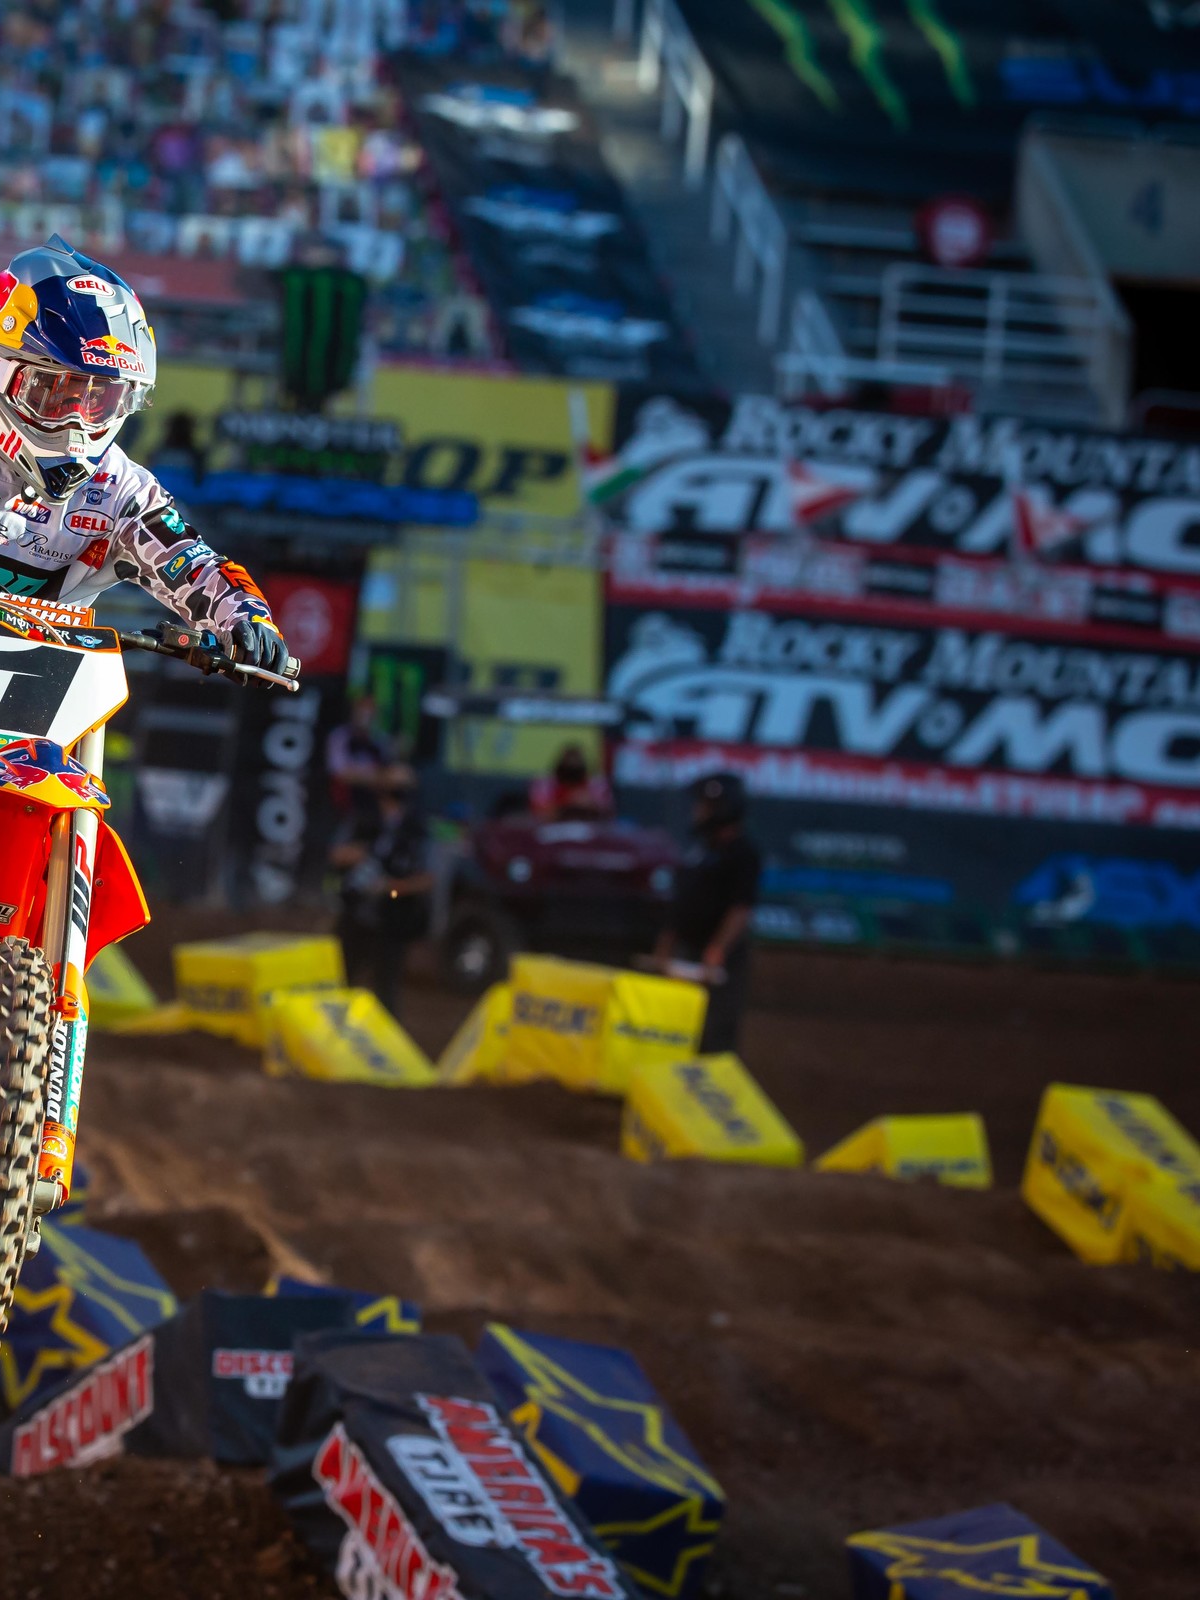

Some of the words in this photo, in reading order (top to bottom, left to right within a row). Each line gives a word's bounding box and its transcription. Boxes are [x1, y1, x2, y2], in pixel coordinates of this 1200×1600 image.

[74, 279, 109, 294] BELL
[82, 351, 117, 369] Red
[118, 354, 147, 376] Bull
[724, 396, 933, 468] ROCKY
[14, 498, 48, 524] 100%
[70, 515, 108, 532] BELL
[718, 605, 912, 679] ROCKY
[386, 1436, 518, 1546] TIRE
[413, 1394, 626, 1598] AMERICA'S
